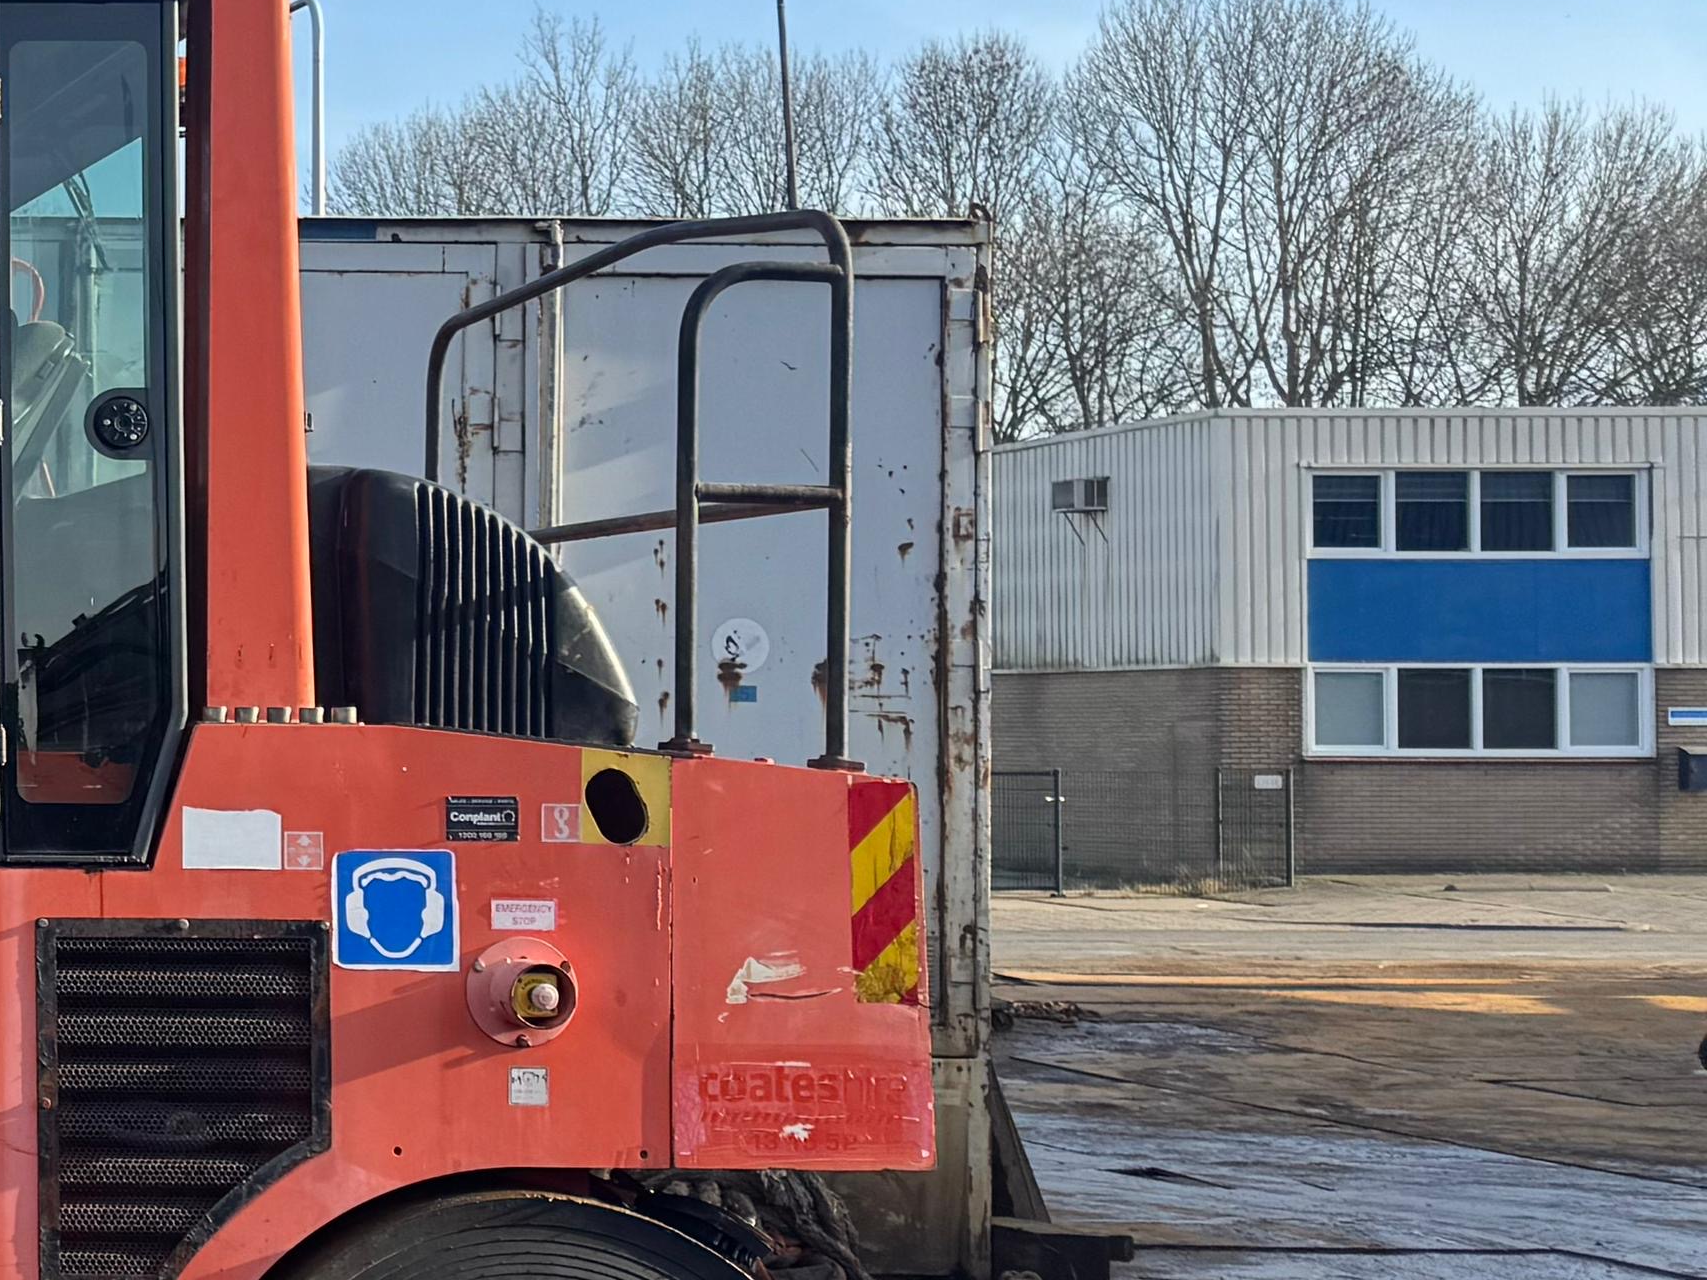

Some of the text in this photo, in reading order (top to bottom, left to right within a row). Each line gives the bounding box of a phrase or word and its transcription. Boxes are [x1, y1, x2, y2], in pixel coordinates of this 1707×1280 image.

[449, 811, 502, 825] Conplant
[495, 904, 552, 914] EMERGENCY
[512, 917, 536, 926] STOP
[699, 1066, 841, 1103] coates
